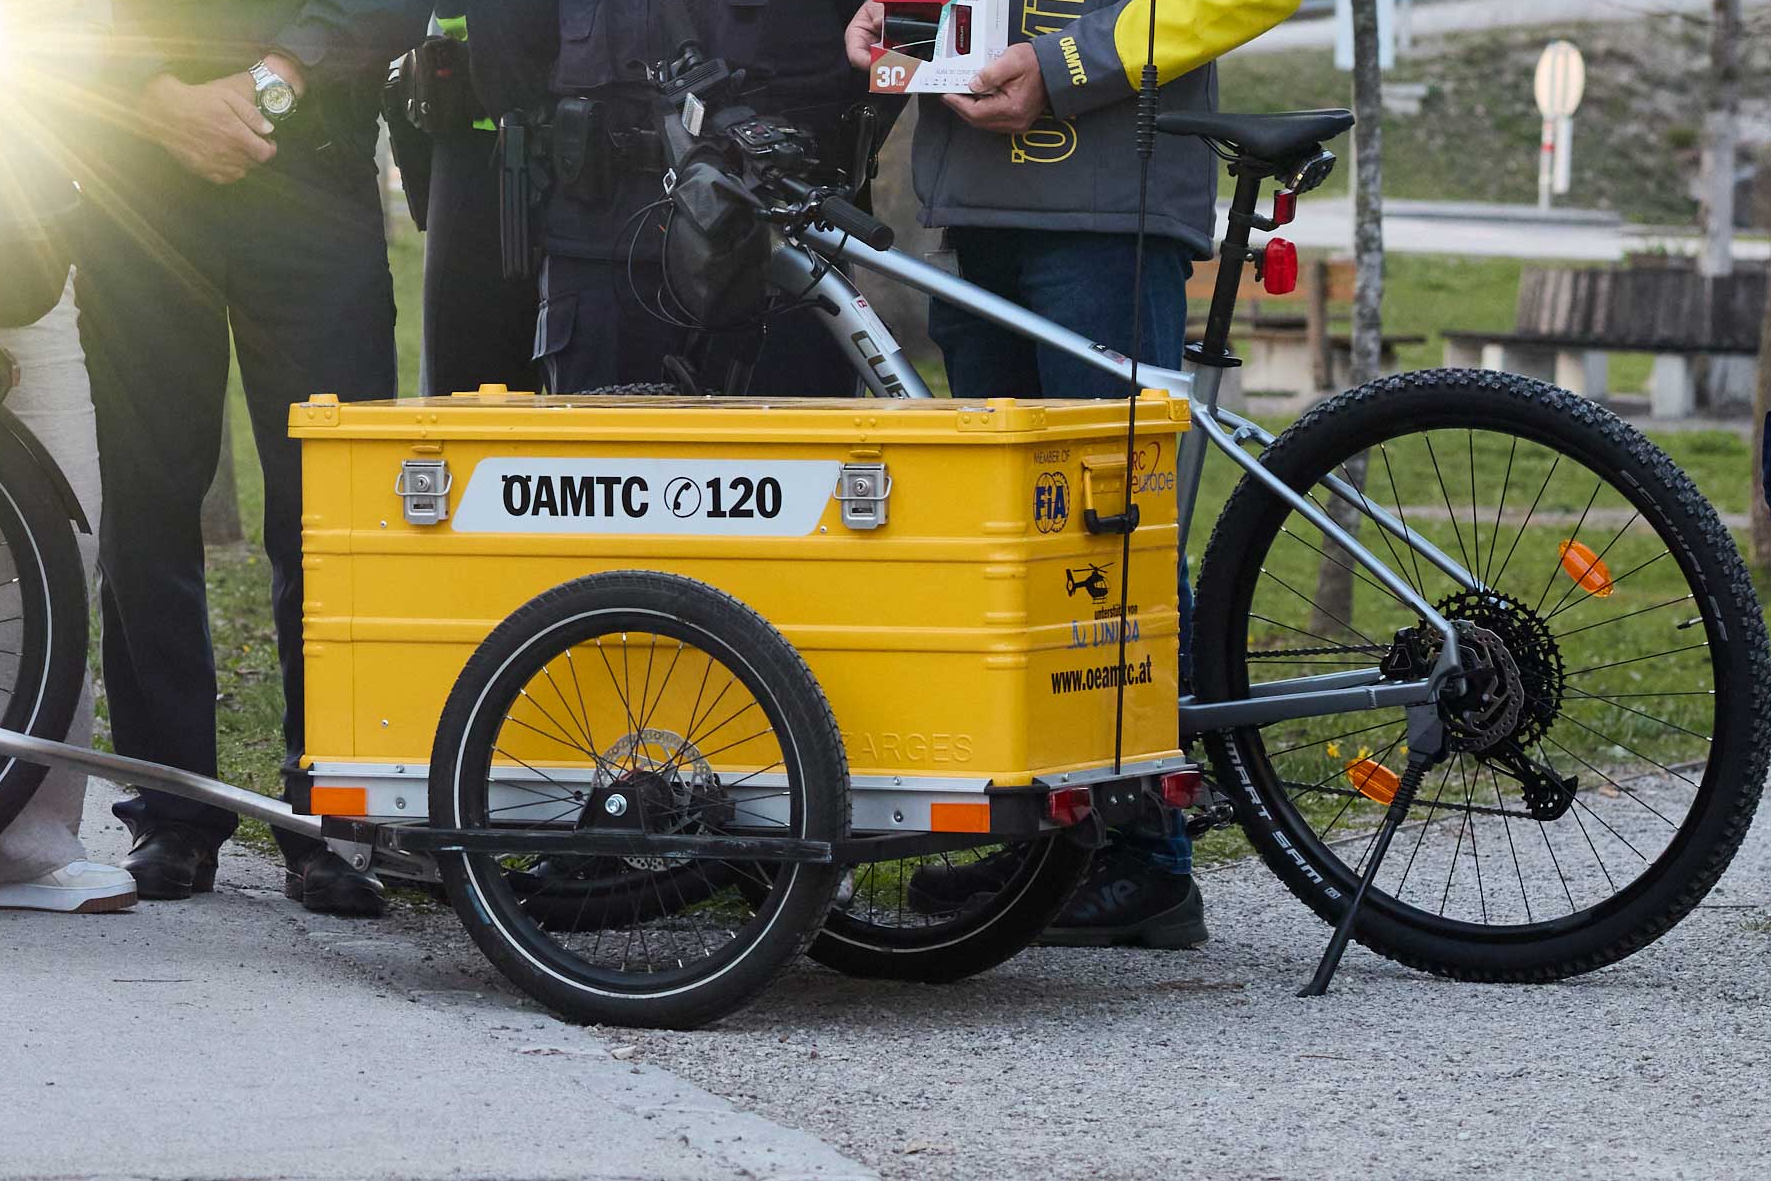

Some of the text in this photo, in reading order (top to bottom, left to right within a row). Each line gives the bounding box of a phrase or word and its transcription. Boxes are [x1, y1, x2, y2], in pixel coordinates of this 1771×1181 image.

[1059, 36, 1088, 86] ÖAMTC
[1034, 453, 1061, 464] MEMBER
[502, 475, 782, 519] ÖAMTC 120
[1132, 471, 1174, 498] europe
